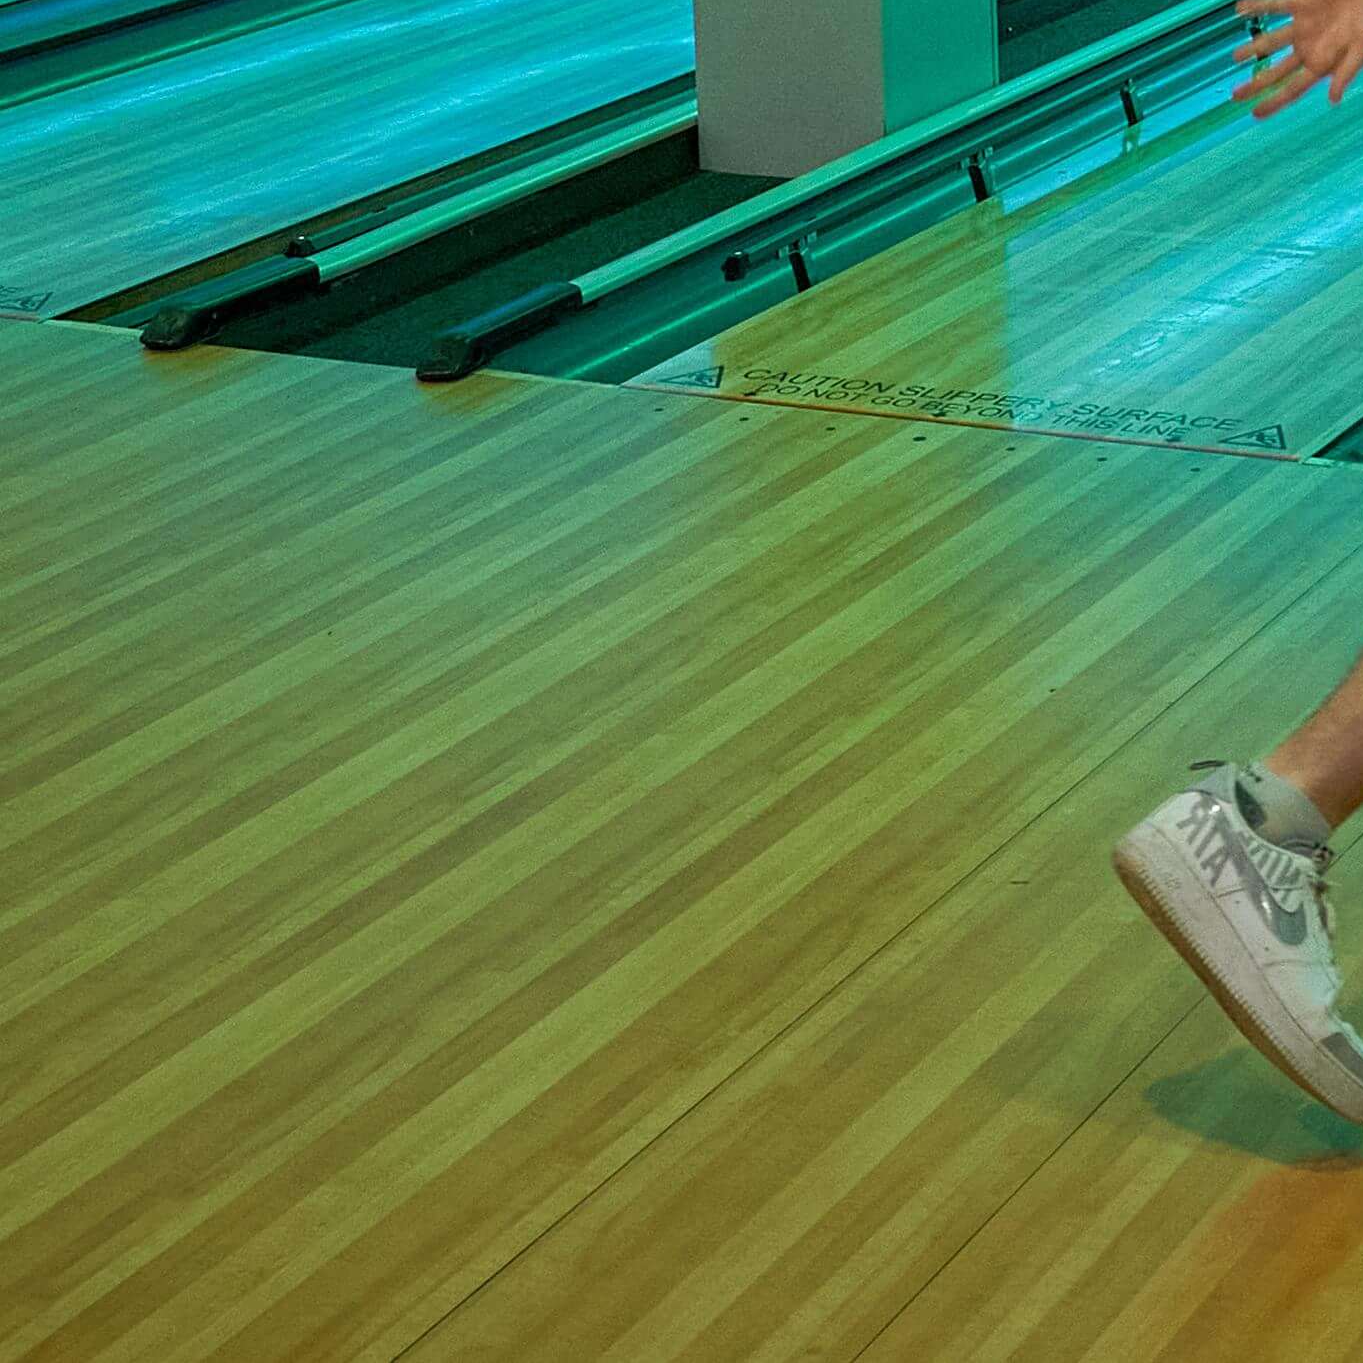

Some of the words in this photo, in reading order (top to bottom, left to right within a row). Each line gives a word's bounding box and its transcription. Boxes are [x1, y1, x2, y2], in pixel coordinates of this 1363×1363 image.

[744, 368, 895, 393] CAUTION
[898, 385, 1068, 412] SLIPPERY
[1073, 403, 1244, 430] SURFACE
[757, 384, 801, 395] DO
[809, 388, 865, 402] NOT
[872, 396, 917, 408] GO
[921, 399, 1042, 421] BEYOND
[1052, 414, 1114, 430] THIS
[1120, 422, 1190, 438] LINE
